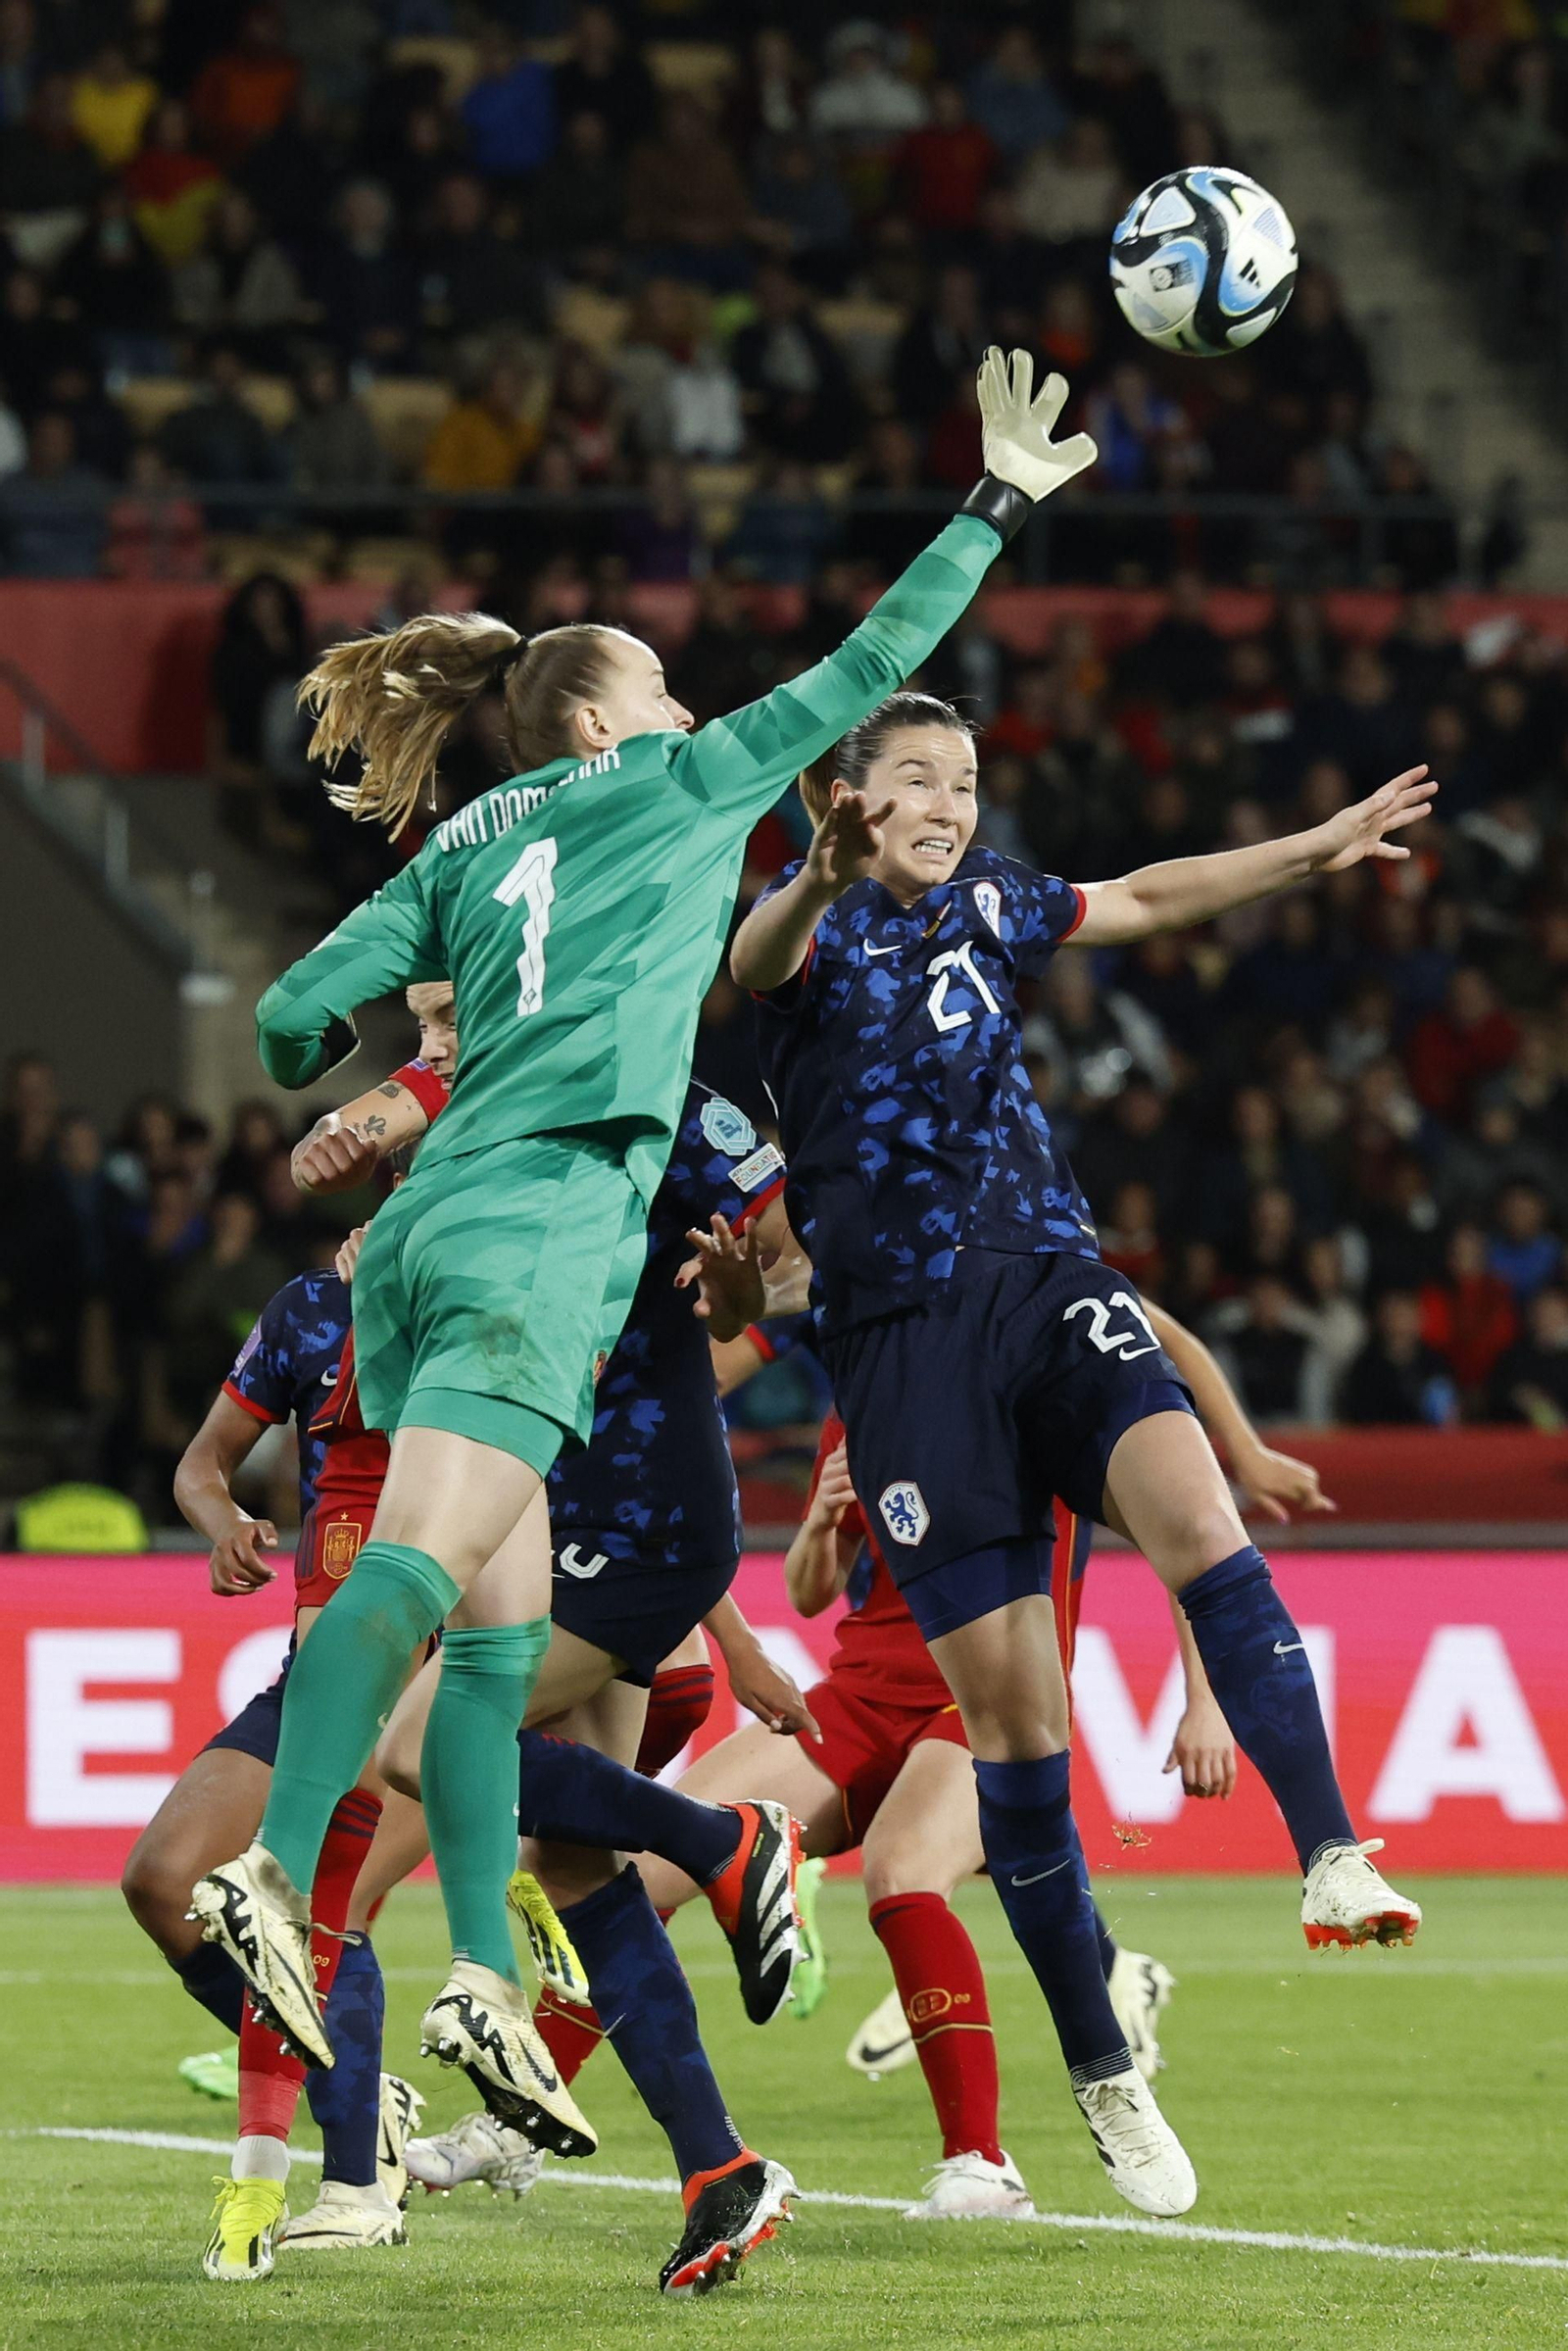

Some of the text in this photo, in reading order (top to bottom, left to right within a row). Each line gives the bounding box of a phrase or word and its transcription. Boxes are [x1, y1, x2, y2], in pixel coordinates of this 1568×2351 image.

[436, 798, 488, 853] VAN
[492, 836, 559, 1018] 1
[926, 940, 1002, 1033] 21
[1062, 1291, 1161, 1353] 21
